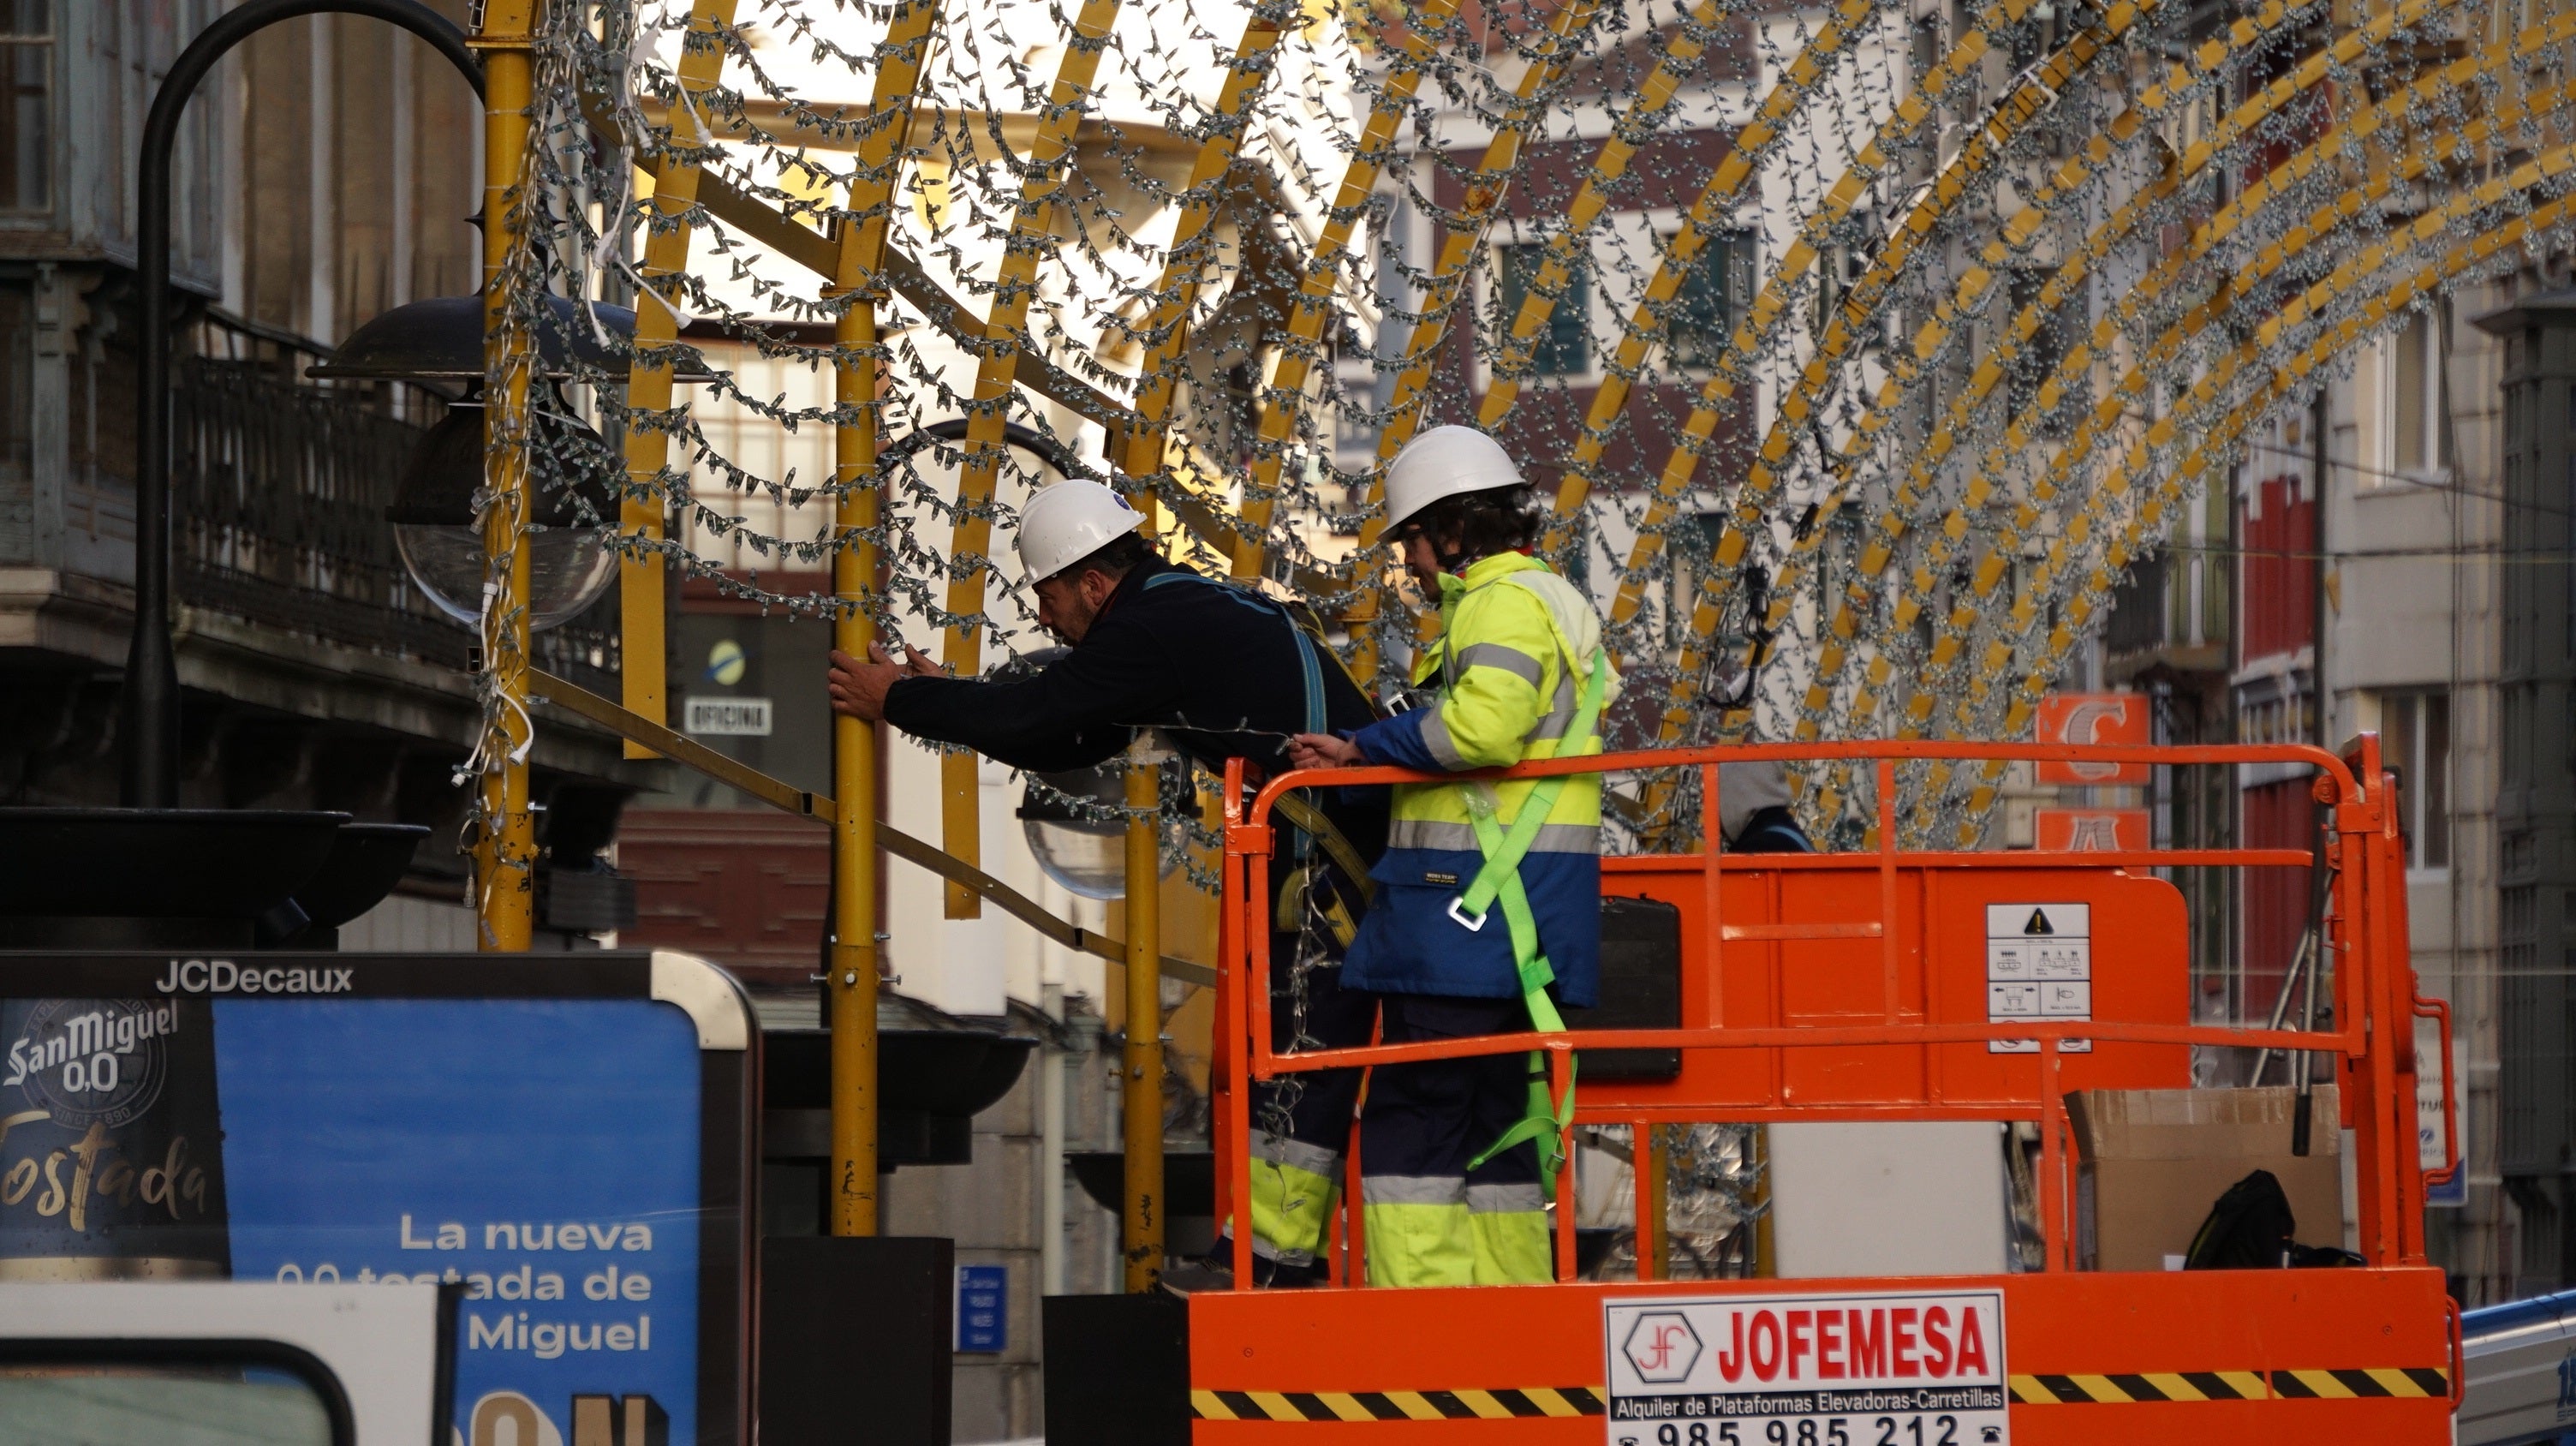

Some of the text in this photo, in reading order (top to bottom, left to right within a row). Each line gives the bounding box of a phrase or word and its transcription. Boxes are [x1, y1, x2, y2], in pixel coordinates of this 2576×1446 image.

[695, 705, 762, 728] OFICINA
[156, 959, 355, 994] JCDecaux
[63, 1051, 119, 1093] 0,0
[401, 1214, 653, 1252] La nueva
[583, 1265, 653, 1301] de
[469, 1312, 650, 1359] Miguel
[1718, 1305, 1989, 1383] JOFEMESA
[1617, 1387, 2002, 1421] Alquiler de Plataformas Elevadoras-Carretillas
[1657, 1414, 1959, 1446] 985 985 212
